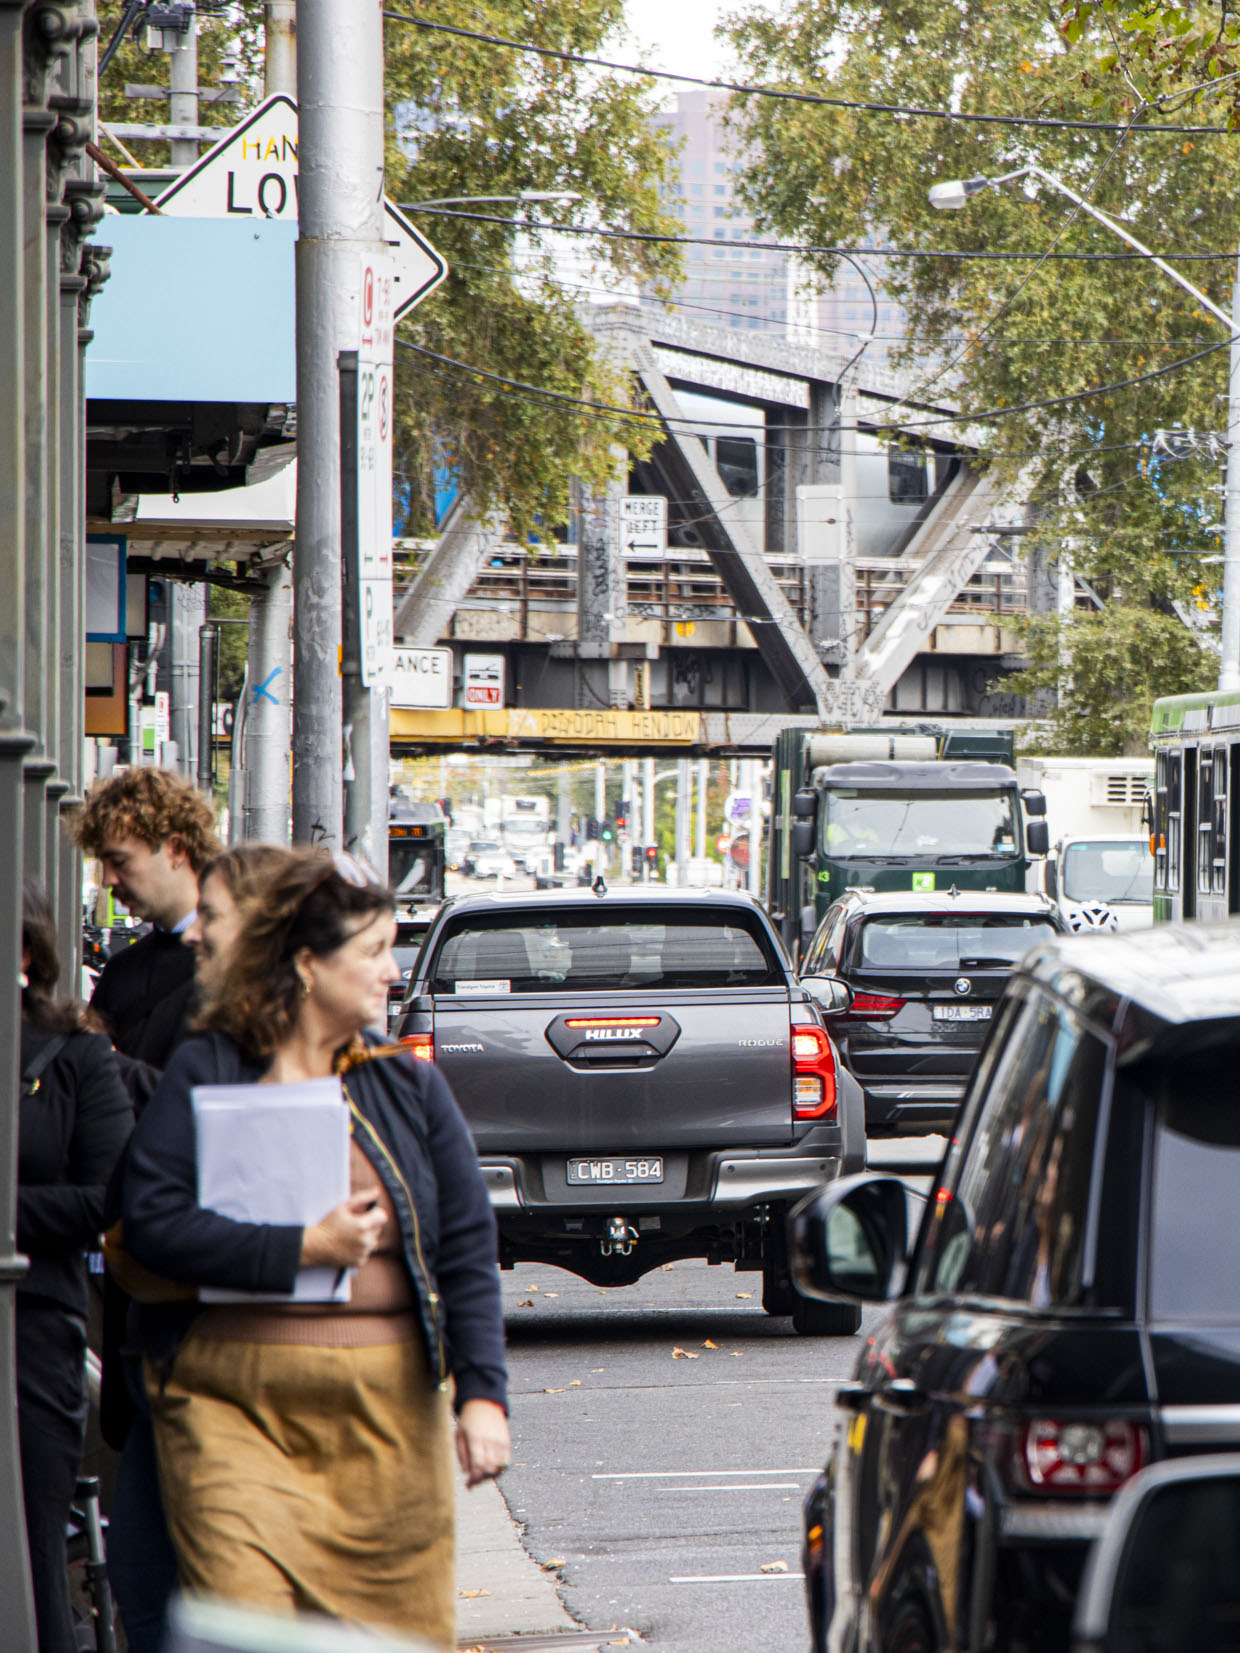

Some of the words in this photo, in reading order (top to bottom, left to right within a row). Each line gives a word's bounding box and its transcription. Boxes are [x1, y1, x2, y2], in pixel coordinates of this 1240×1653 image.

[242, 134, 299, 162] HAN
[227, 171, 299, 219] LO
[624, 501, 659, 515] MERGE
[393, 655, 441, 674] ANCE
[585, 1028, 644, 1040] HILUX
[440, 1043, 485, 1053] TOYOTA
[738, 1039, 784, 1047] ROGUE
[577, 1161, 614, 1179] CWB
[625, 1160, 661, 1178] 584
